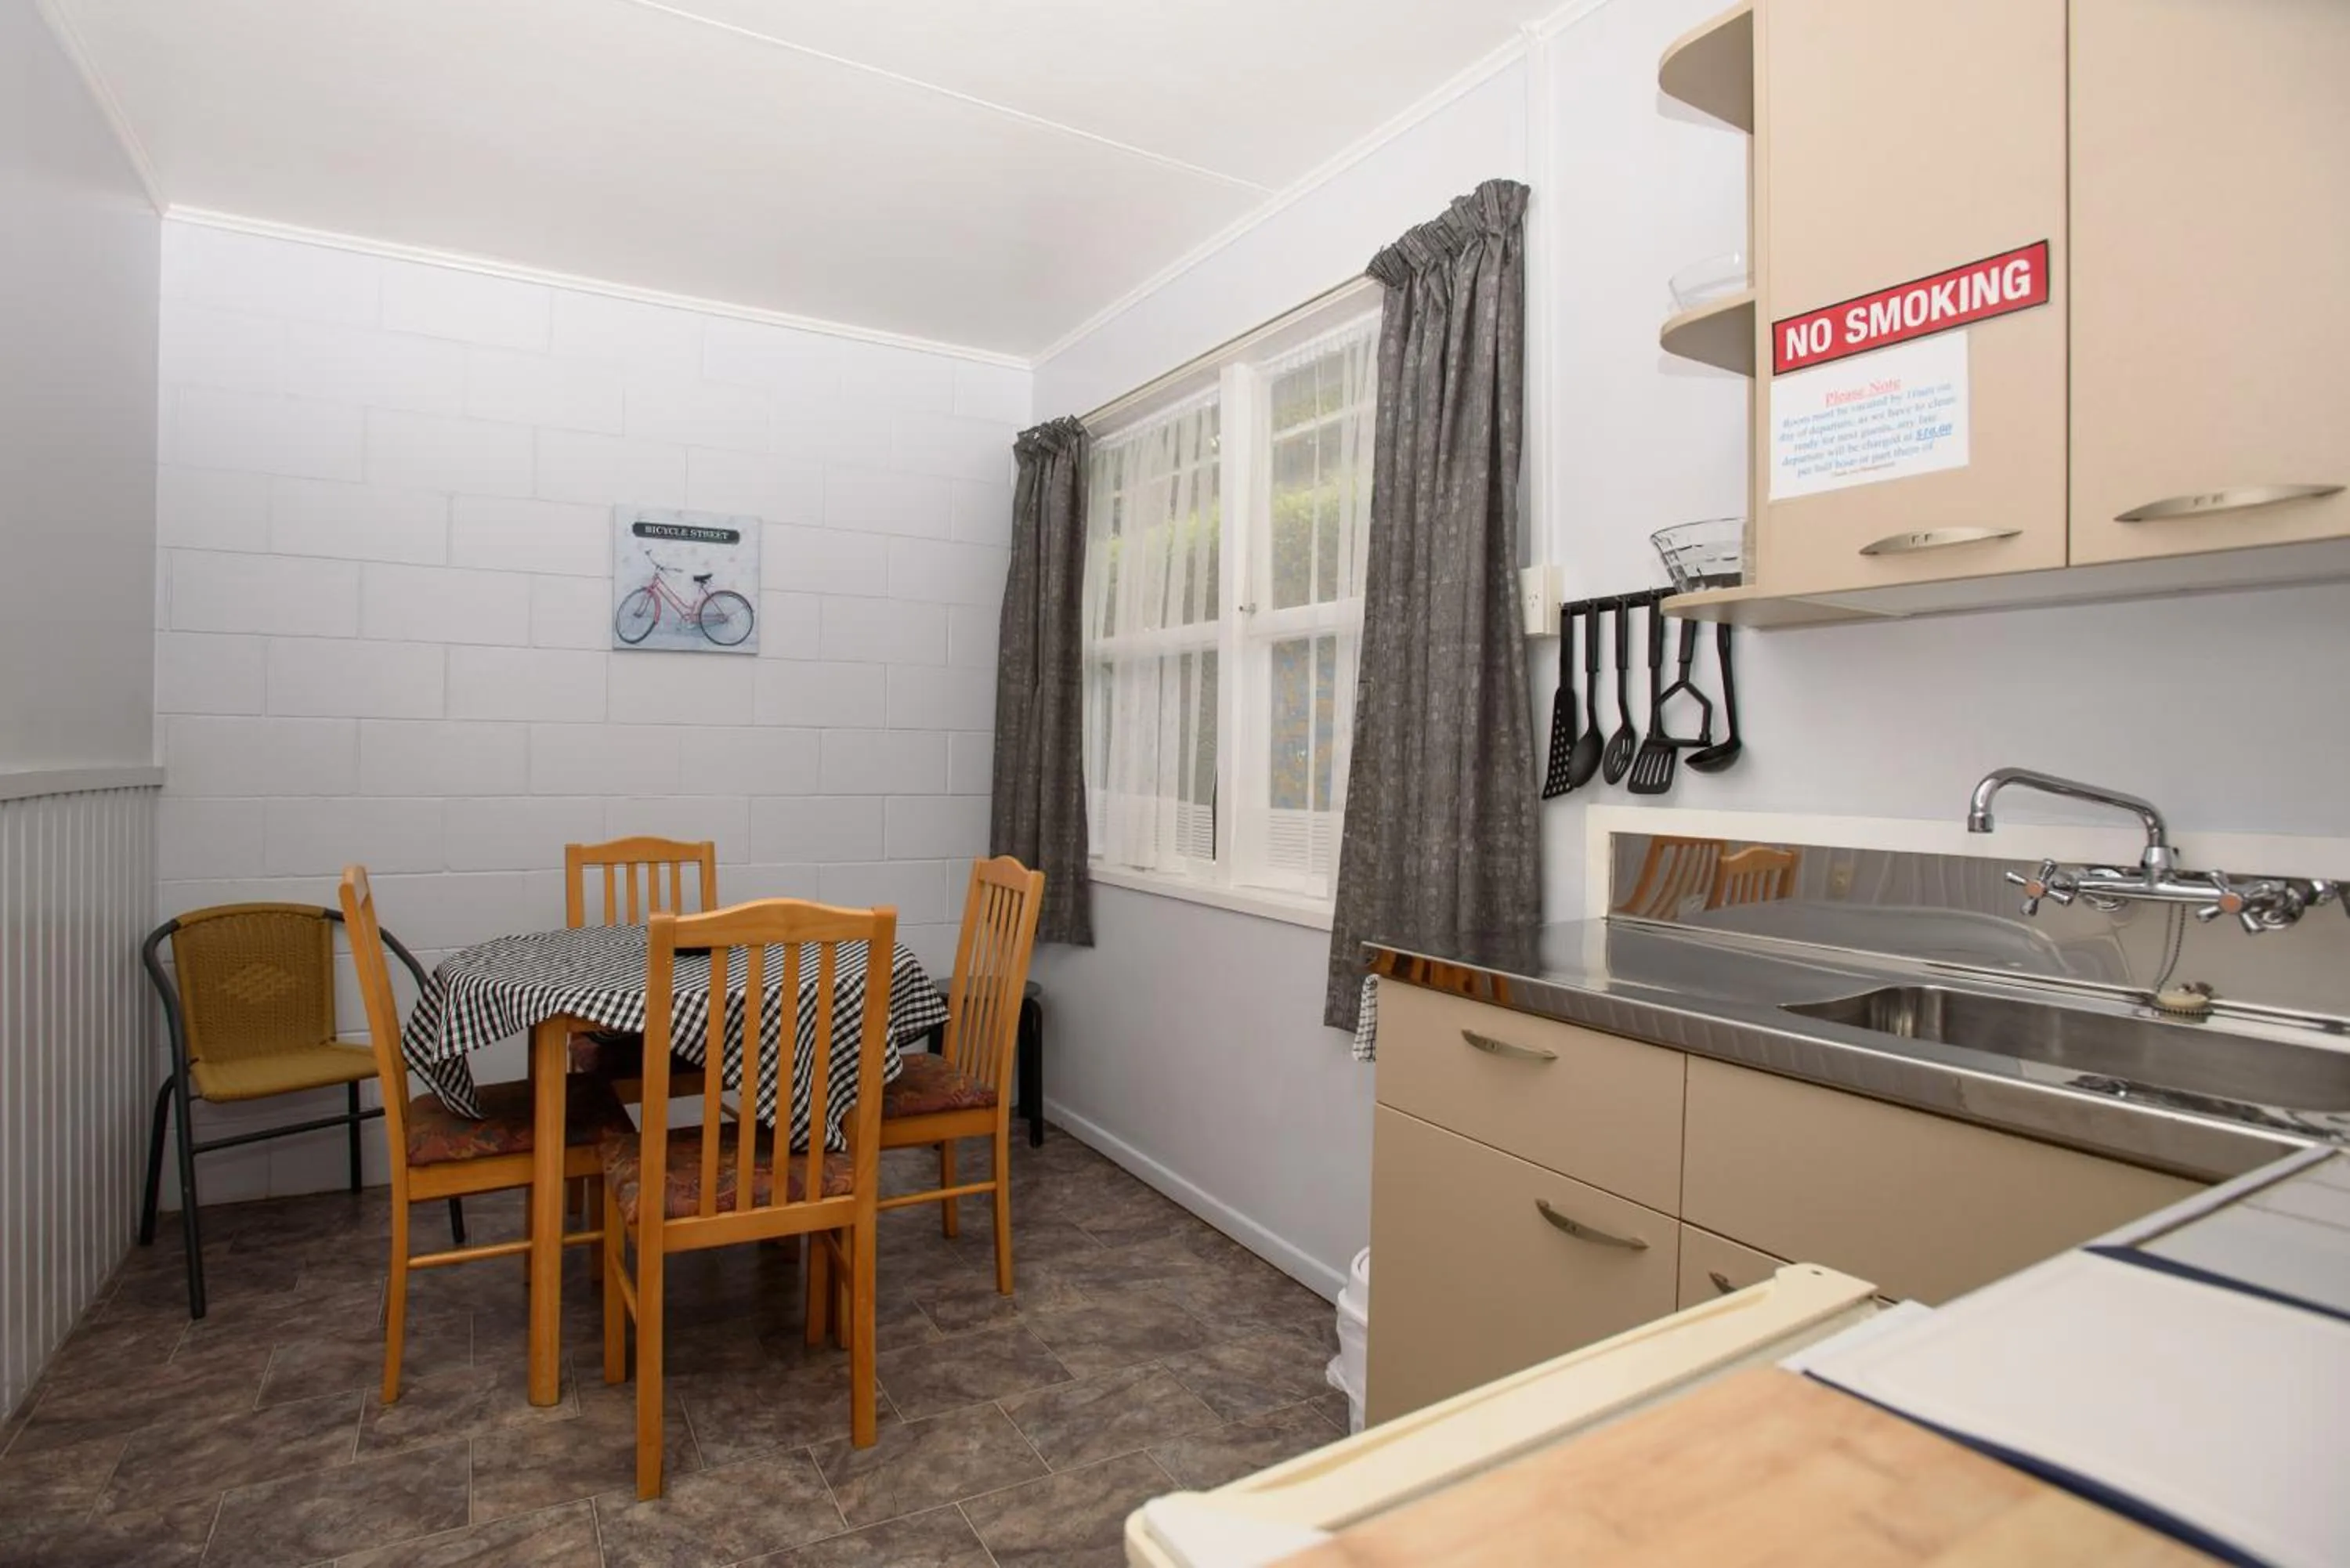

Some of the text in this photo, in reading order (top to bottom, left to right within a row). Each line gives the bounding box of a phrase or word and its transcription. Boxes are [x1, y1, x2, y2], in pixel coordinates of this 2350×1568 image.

[1786, 259, 2030, 361] NO SMOKING
[1826, 378, 1900, 406] Please Note
[645, 526, 728, 540] BICYCLE STREET
